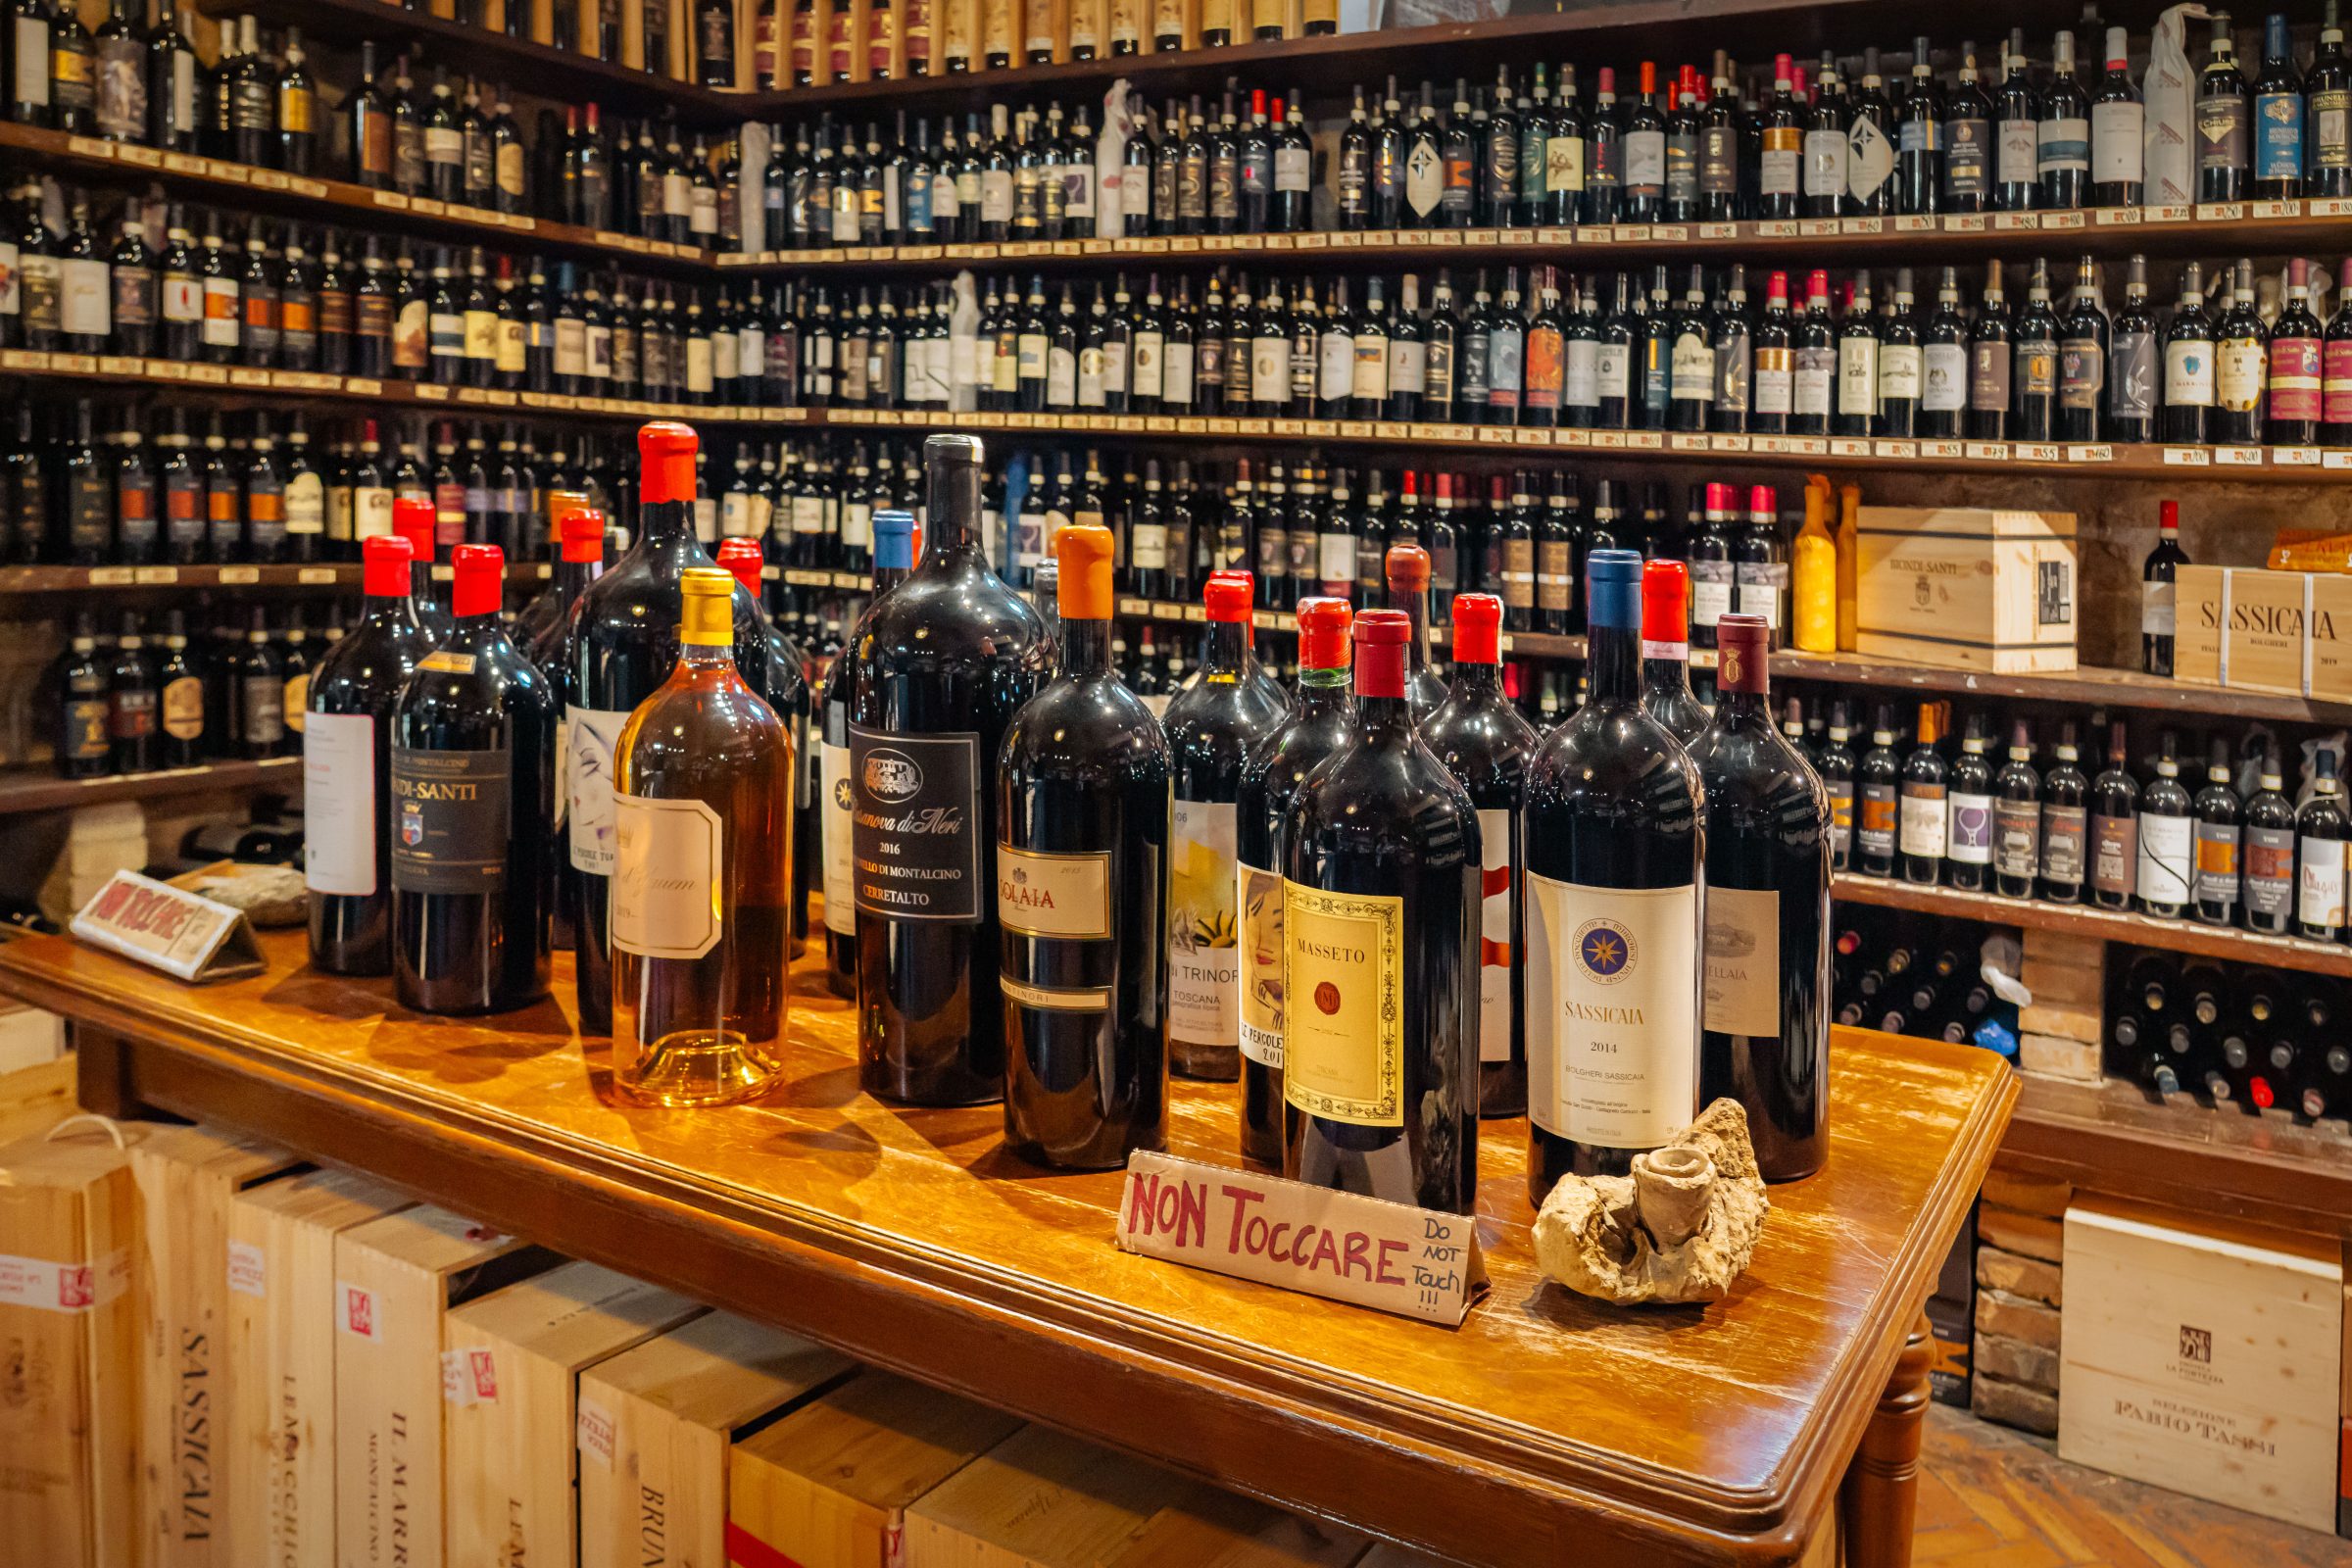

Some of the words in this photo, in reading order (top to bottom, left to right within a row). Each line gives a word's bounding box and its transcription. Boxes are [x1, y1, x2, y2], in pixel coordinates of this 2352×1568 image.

[880, 842, 901, 855] 2016
[879, 864, 888, 875] DI
[890, 866, 961, 880] MONTALCINO
[863, 884, 930, 906] CERRETALTO
[1298, 938, 1365, 964] MASSETO
[1709, 965, 1747, 981] ELLAIA
[1174, 990, 1221, 1004] TOSCANA
[1565, 1000, 1644, 1025] SASSICAIA
[1591, 1041, 1617, 1054] 2014
[1565, 1064, 1602, 1078] BOLGHERI
[1604, 1070, 1644, 1081] SASSICAIA
[1128, 1172, 1207, 1249] NON
[1221, 1184, 1410, 1286] TOCCARE
[1424, 1217, 1450, 1241] Do
[1422, 1245, 1461, 1262] NOT
[1412, 1265, 1460, 1295] Touch
[2152, 1397, 2237, 1428] SELEZIONE
[182, 1327, 211, 1543] SASSICAIA
[2114, 1398, 2191, 1434] FABIO
[2194, 1421, 2277, 1458] TASSI
[392, 1454, 409, 1568] MARR
